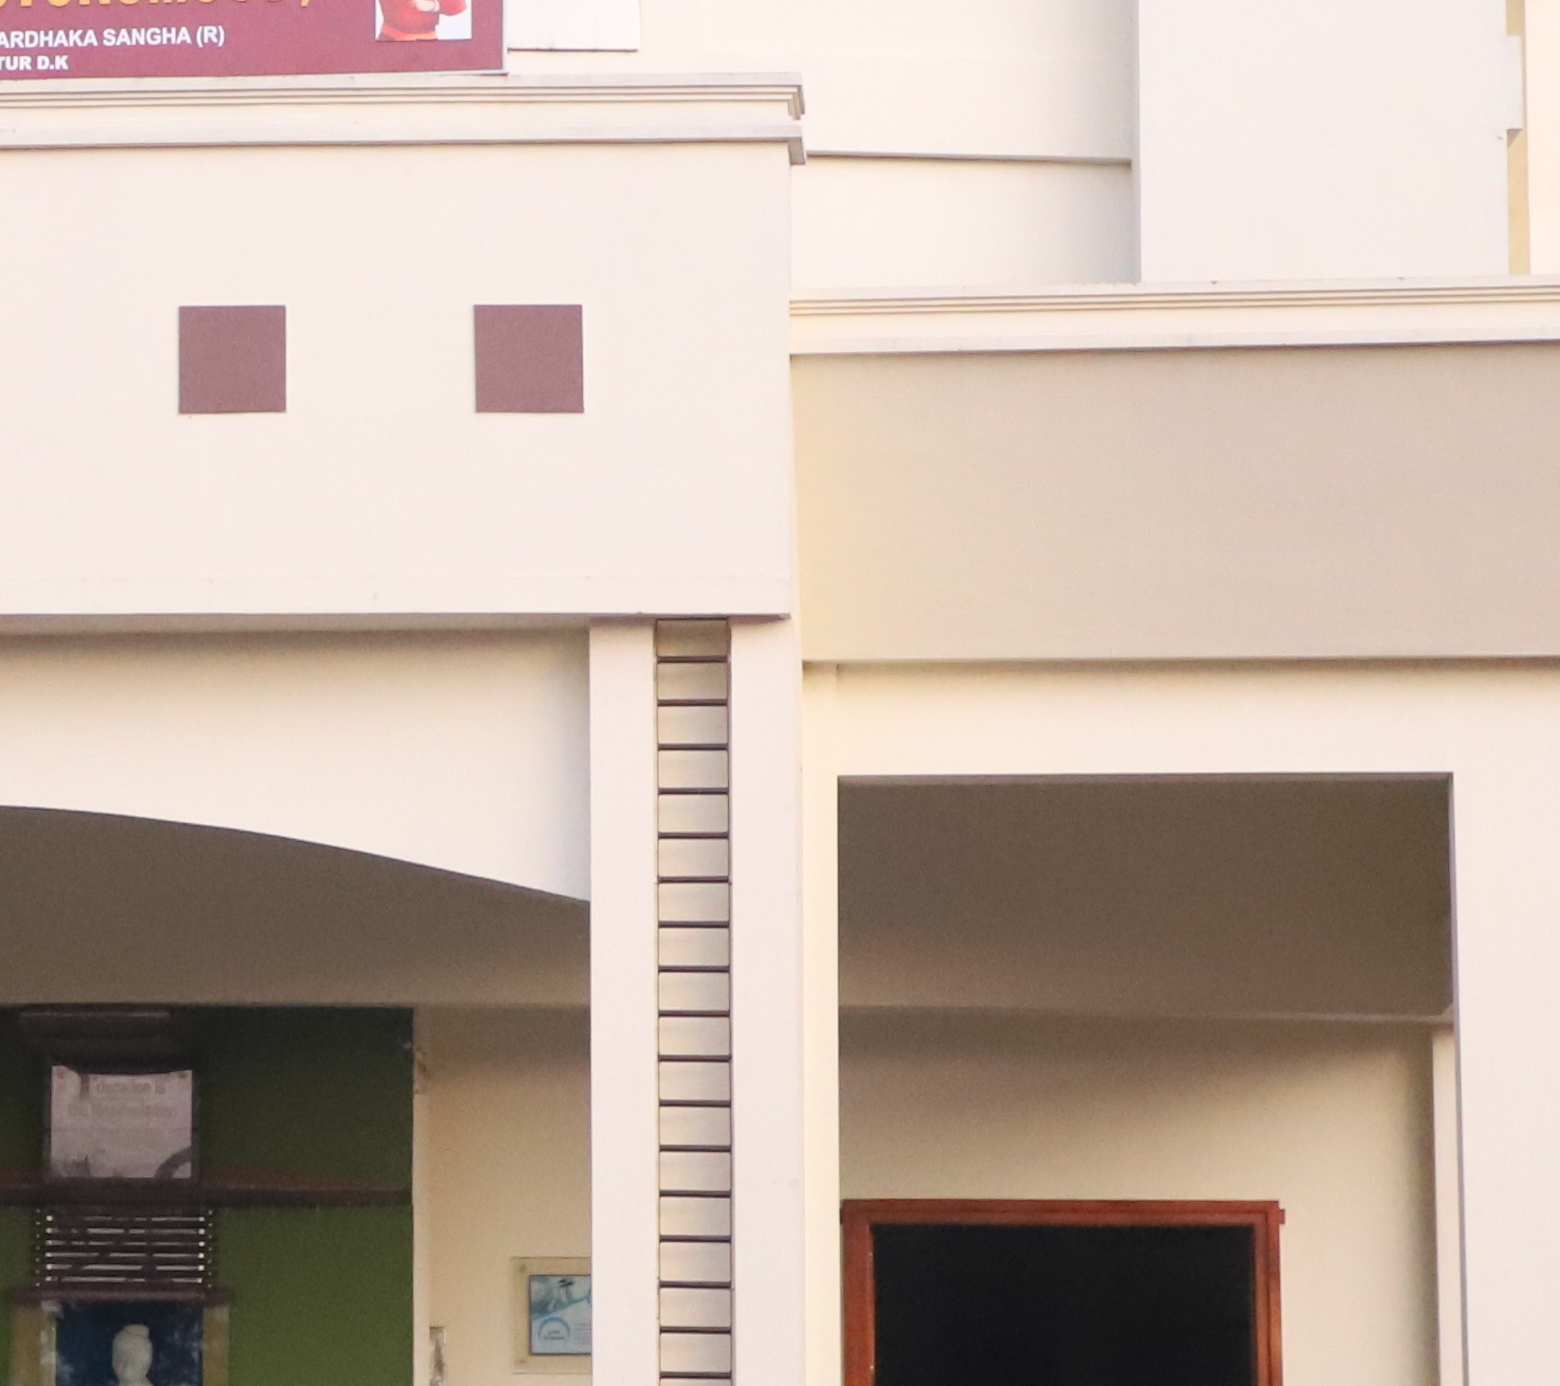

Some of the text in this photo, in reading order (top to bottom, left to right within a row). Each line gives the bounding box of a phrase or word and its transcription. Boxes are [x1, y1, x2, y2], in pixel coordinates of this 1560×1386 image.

[102, 26, 192, 47] SANGHA
[196, 25, 225, 48] (R)
[37, 55, 69, 70] D.K
